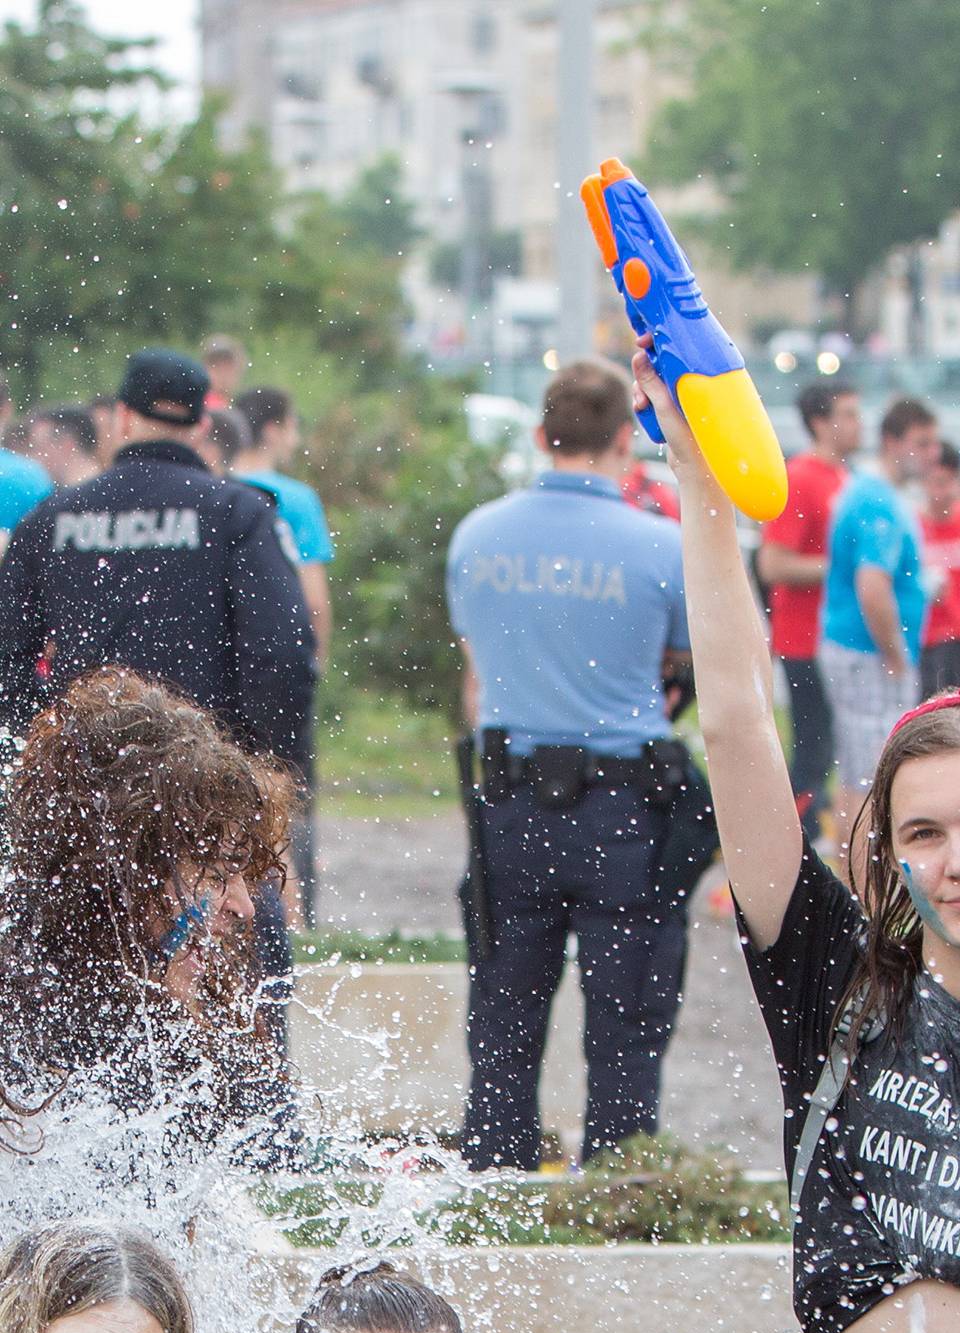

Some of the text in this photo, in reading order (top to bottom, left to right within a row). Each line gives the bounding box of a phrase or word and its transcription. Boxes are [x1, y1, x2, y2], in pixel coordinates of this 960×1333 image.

[54, 508, 199, 551] POLICIJA
[473, 553, 627, 605] POLICIJA
[859, 1125, 926, 1175] KANT
[925, 1150, 939, 1182] I
[867, 1191, 919, 1240] VAKI
